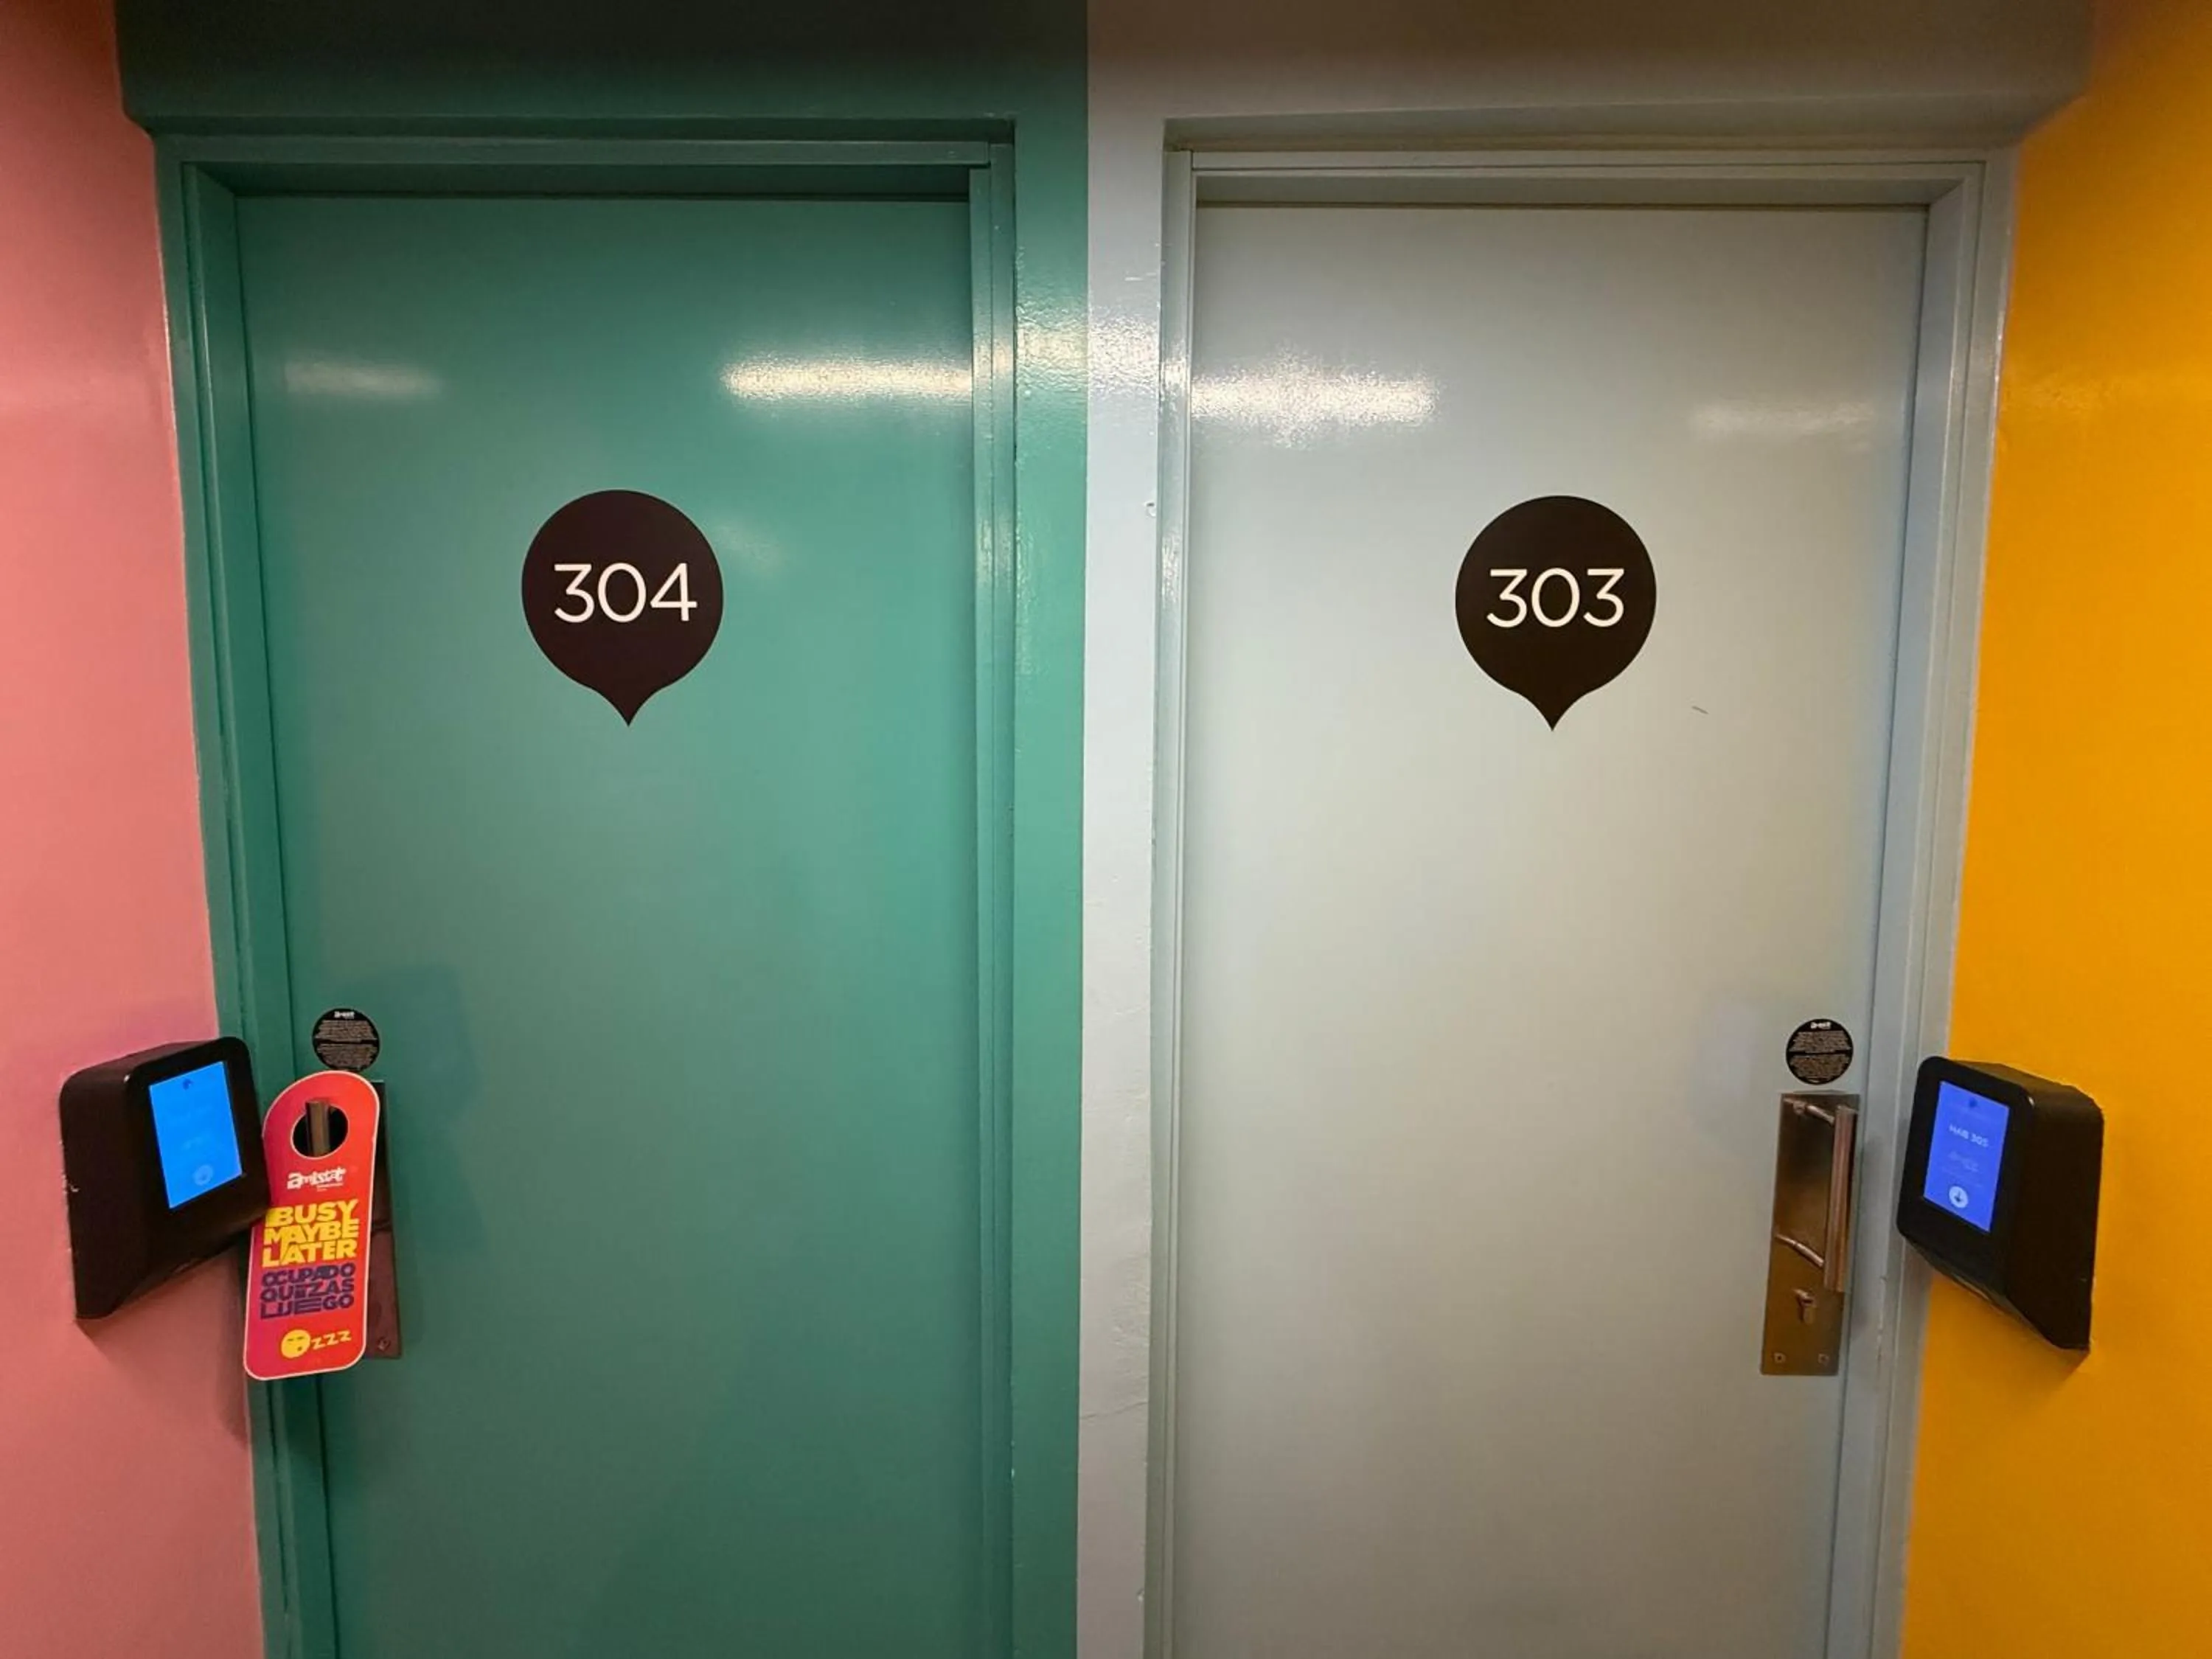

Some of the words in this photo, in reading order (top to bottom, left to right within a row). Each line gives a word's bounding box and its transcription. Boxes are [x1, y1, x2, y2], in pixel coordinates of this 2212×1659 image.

[554, 563, 698, 623] 304
[1486, 568, 1624, 627] 303
[265, 1199, 358, 1228] BUSY
[264, 1218, 359, 1245] MAYBE
[262, 1239, 358, 1267] LATER
[262, 1262, 355, 1287] OCUPADO
[260, 1295, 354, 1319] LUEGO
